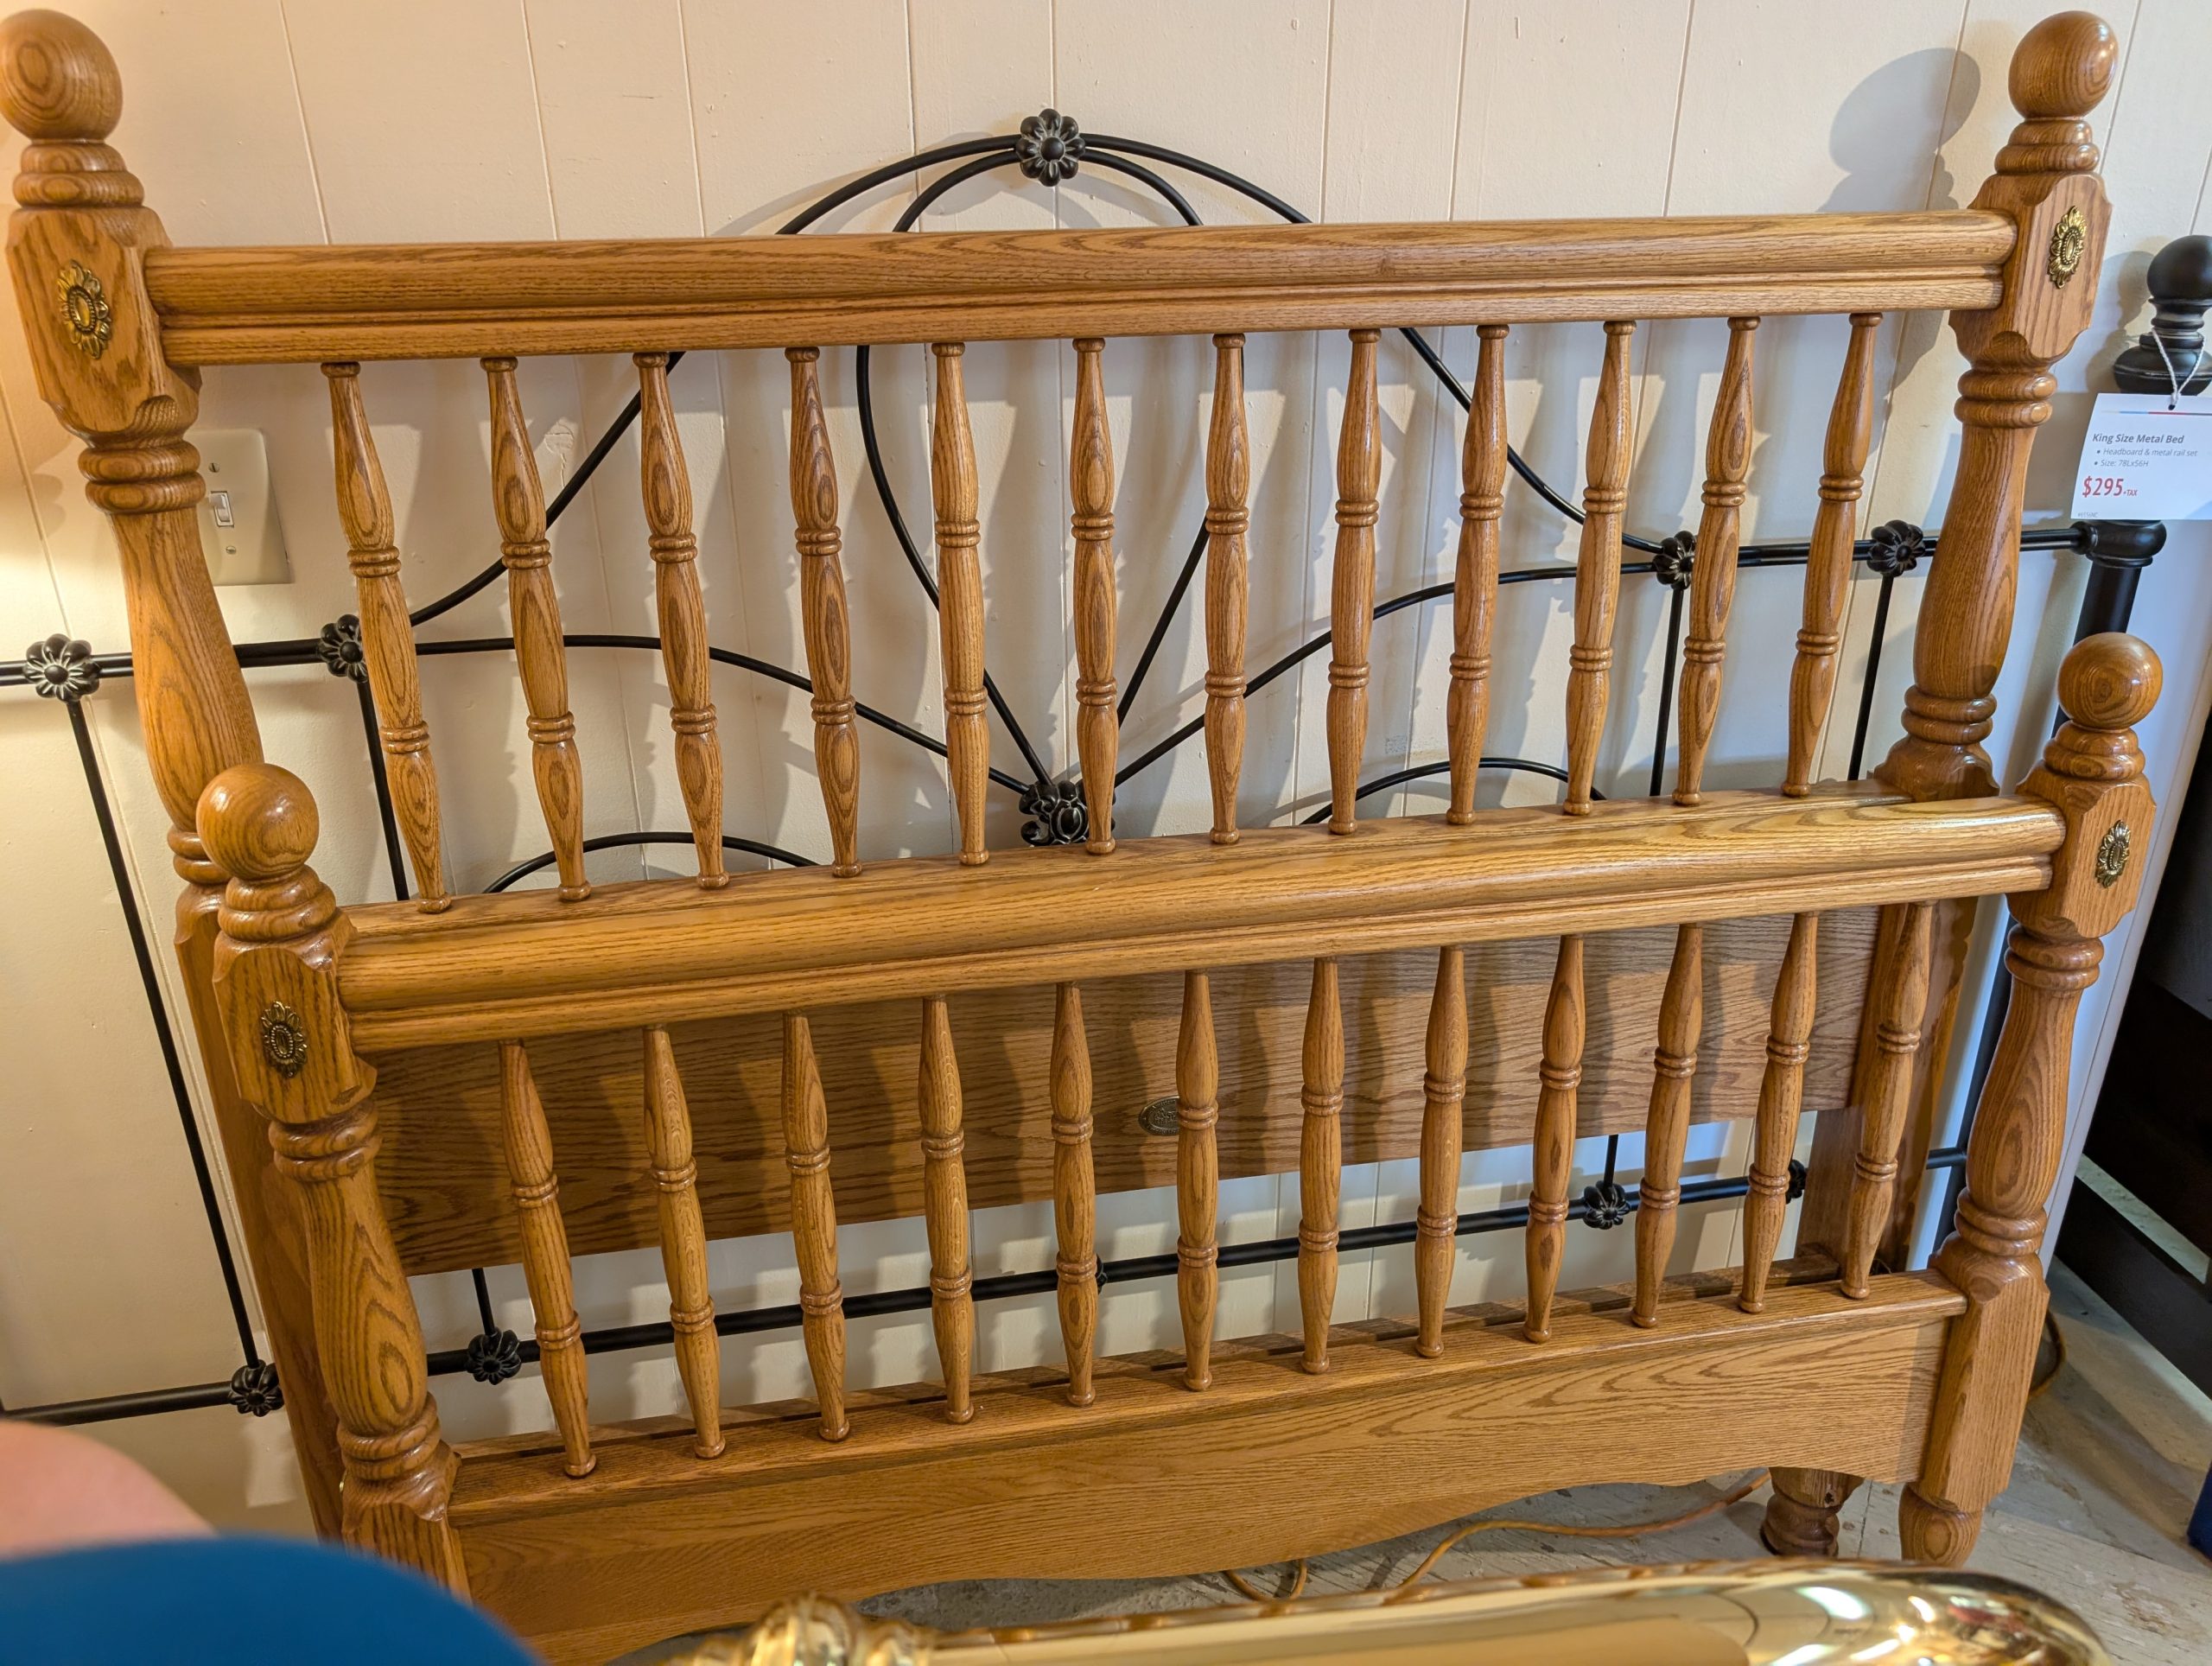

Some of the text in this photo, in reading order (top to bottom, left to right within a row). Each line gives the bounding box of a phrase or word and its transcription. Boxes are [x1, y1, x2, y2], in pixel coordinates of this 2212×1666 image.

[2092, 433, 2113, 444] King
[2115, 434, 2134, 443] Size
[2136, 435, 2164, 443] Metal
[2082, 475, 2124, 498] $295
